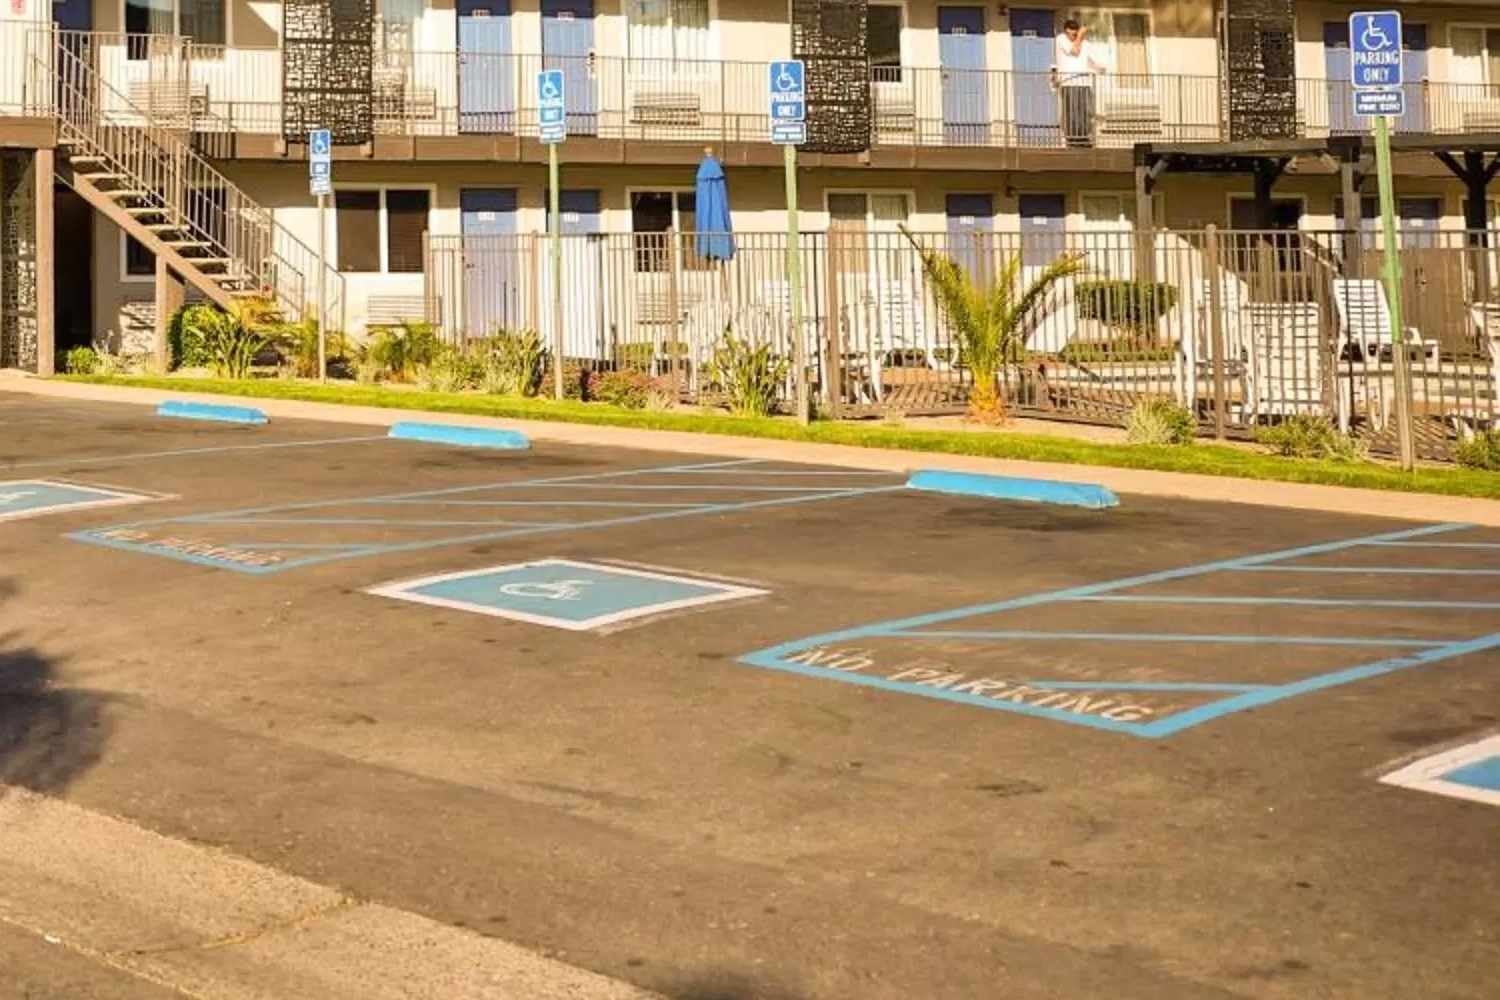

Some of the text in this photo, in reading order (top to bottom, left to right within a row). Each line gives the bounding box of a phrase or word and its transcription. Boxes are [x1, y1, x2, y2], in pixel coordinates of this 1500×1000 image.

[1355, 50, 1399, 65] PARKING
[1363, 67, 1390, 83] ONLY
[785, 650, 1153, 721] NO PARKING
